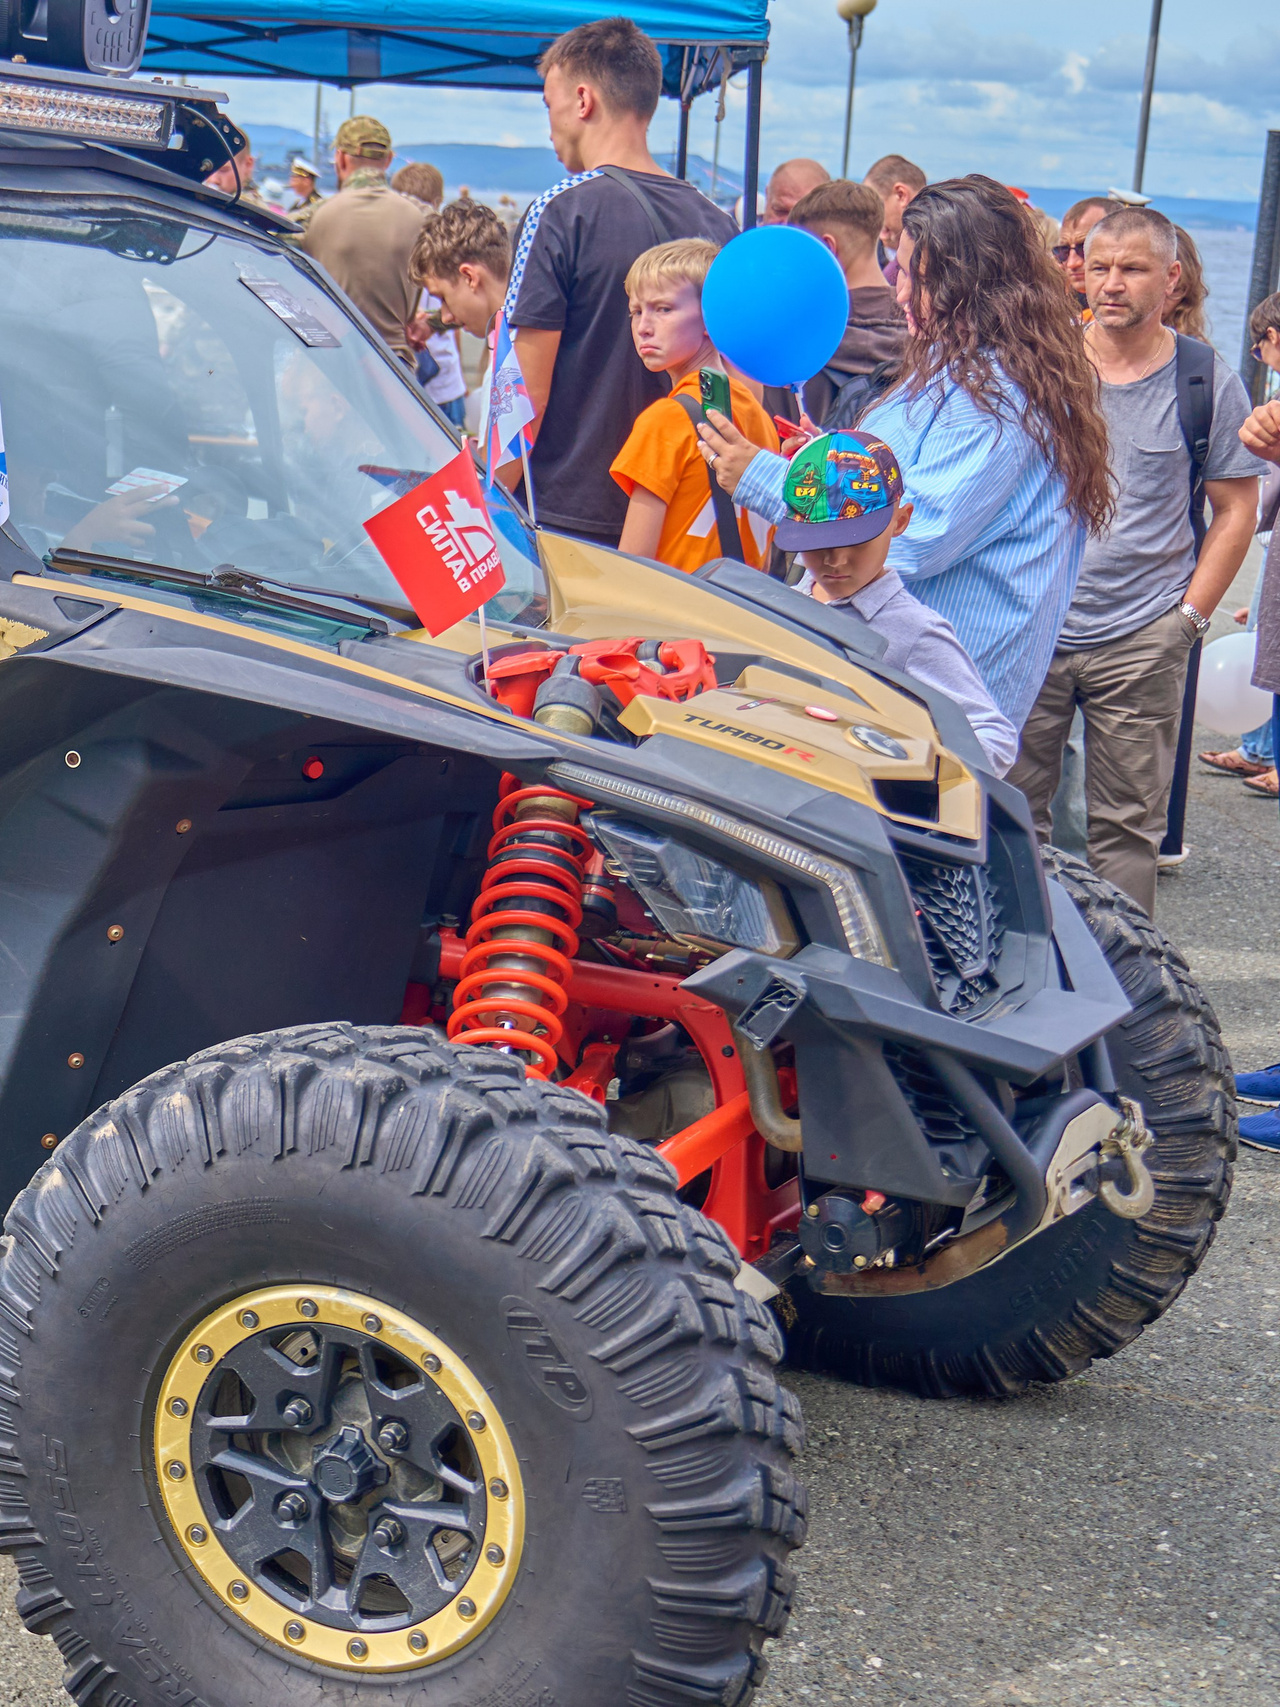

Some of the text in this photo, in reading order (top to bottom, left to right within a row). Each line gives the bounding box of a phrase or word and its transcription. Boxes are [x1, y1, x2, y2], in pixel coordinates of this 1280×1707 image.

[415, 505, 467, 580] СИЛА
[457, 547, 500, 593] В ПРАВ
[684, 713, 786, 750] TURBO
[506, 1305, 589, 1403] ITP
[42, 1433, 113, 1606] CROSS
